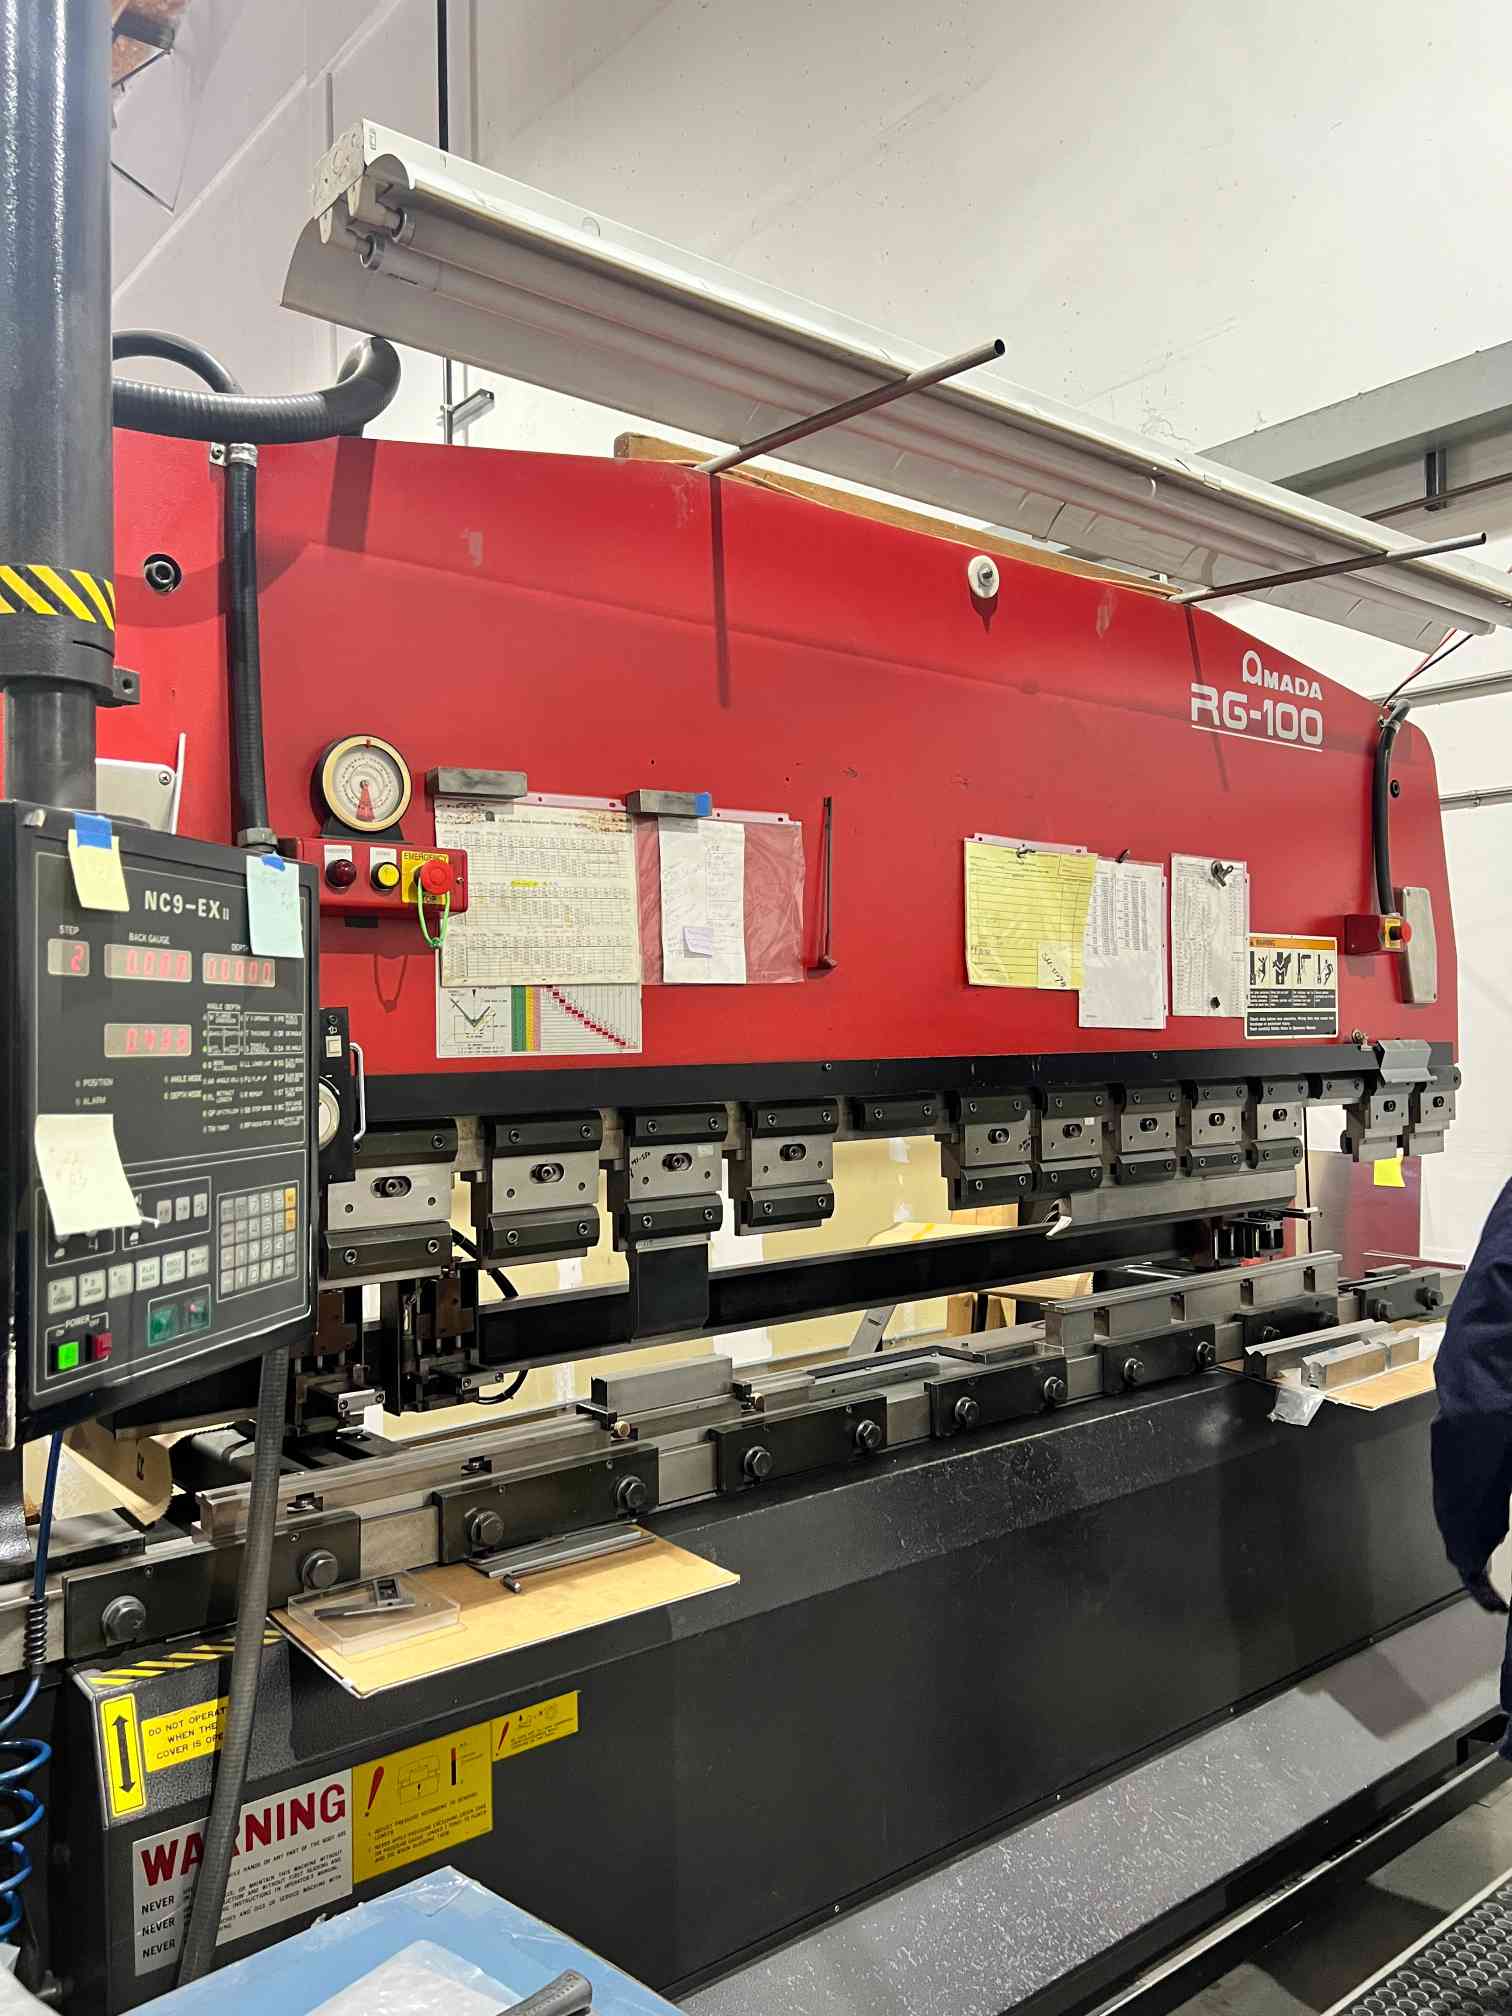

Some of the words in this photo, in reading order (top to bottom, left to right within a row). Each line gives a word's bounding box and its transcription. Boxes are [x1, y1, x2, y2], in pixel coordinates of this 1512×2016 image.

[1242, 650, 1324, 701] AMADA
[1191, 683, 1324, 745] RG-100
[59, 925, 80, 935] STEP
[128, 932, 147, 943] BACK
[65, 1314, 90, 1328] POWER
[148, 1727, 162, 1737] DO
[165, 1719, 184, 1732] NOT
[188, 1707, 225, 1724] OPERAT
[167, 1728, 195, 1744] WHEN
[200, 1721, 217, 1733] THE
[156, 1743, 189, 1760] COVER
[192, 1739, 202, 1749] IS
[205, 1732, 224, 1744] OPE
[141, 1895, 175, 1915] NEVER
[142, 1917, 176, 1937] NEVER
[142, 1938, 176, 1958] NEVER
